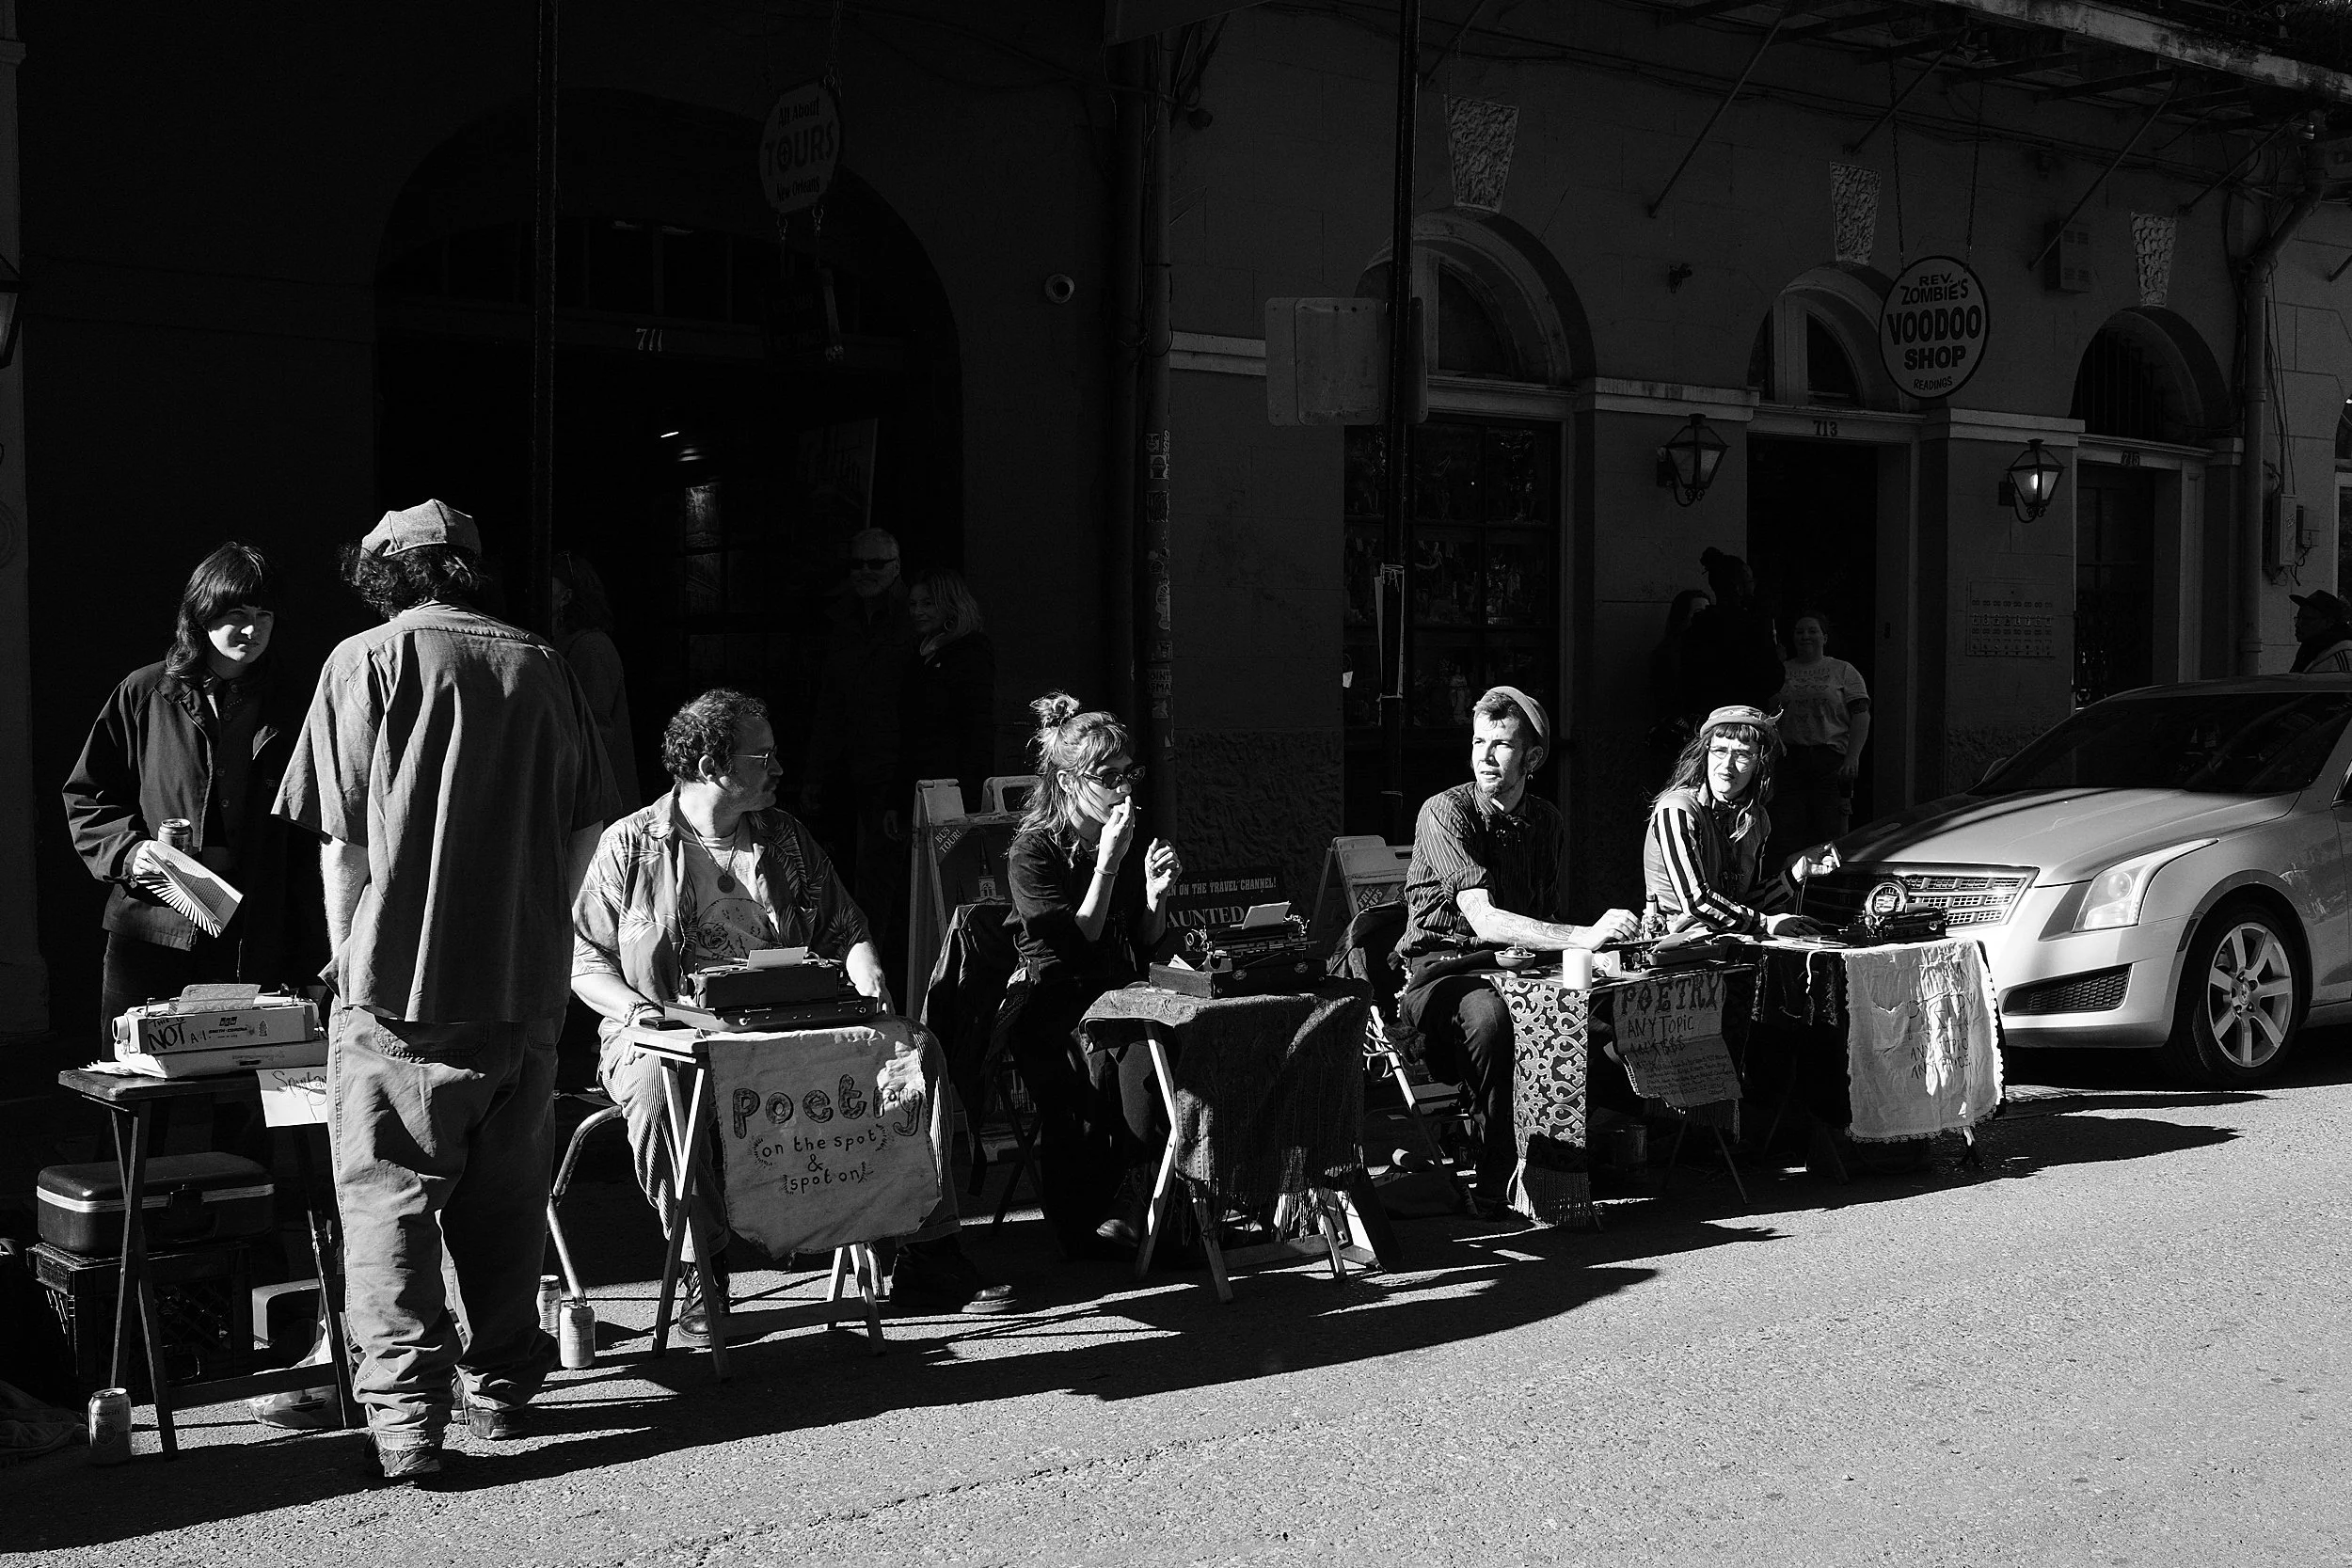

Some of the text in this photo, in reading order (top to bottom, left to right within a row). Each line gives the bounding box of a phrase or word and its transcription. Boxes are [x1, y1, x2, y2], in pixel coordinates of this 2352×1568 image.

[778, 96, 819, 129] All About
[765, 119, 834, 177] TOURS
[1919, 273, 1953, 286] REV.
[1900, 278, 1968, 305] ZOMBIE'S
[1886, 305, 1981, 345] VOODOO
[635, 327, 663, 353] 711
[1904, 345, 1966, 370] SHOP
[1914, 376, 1952, 390] READINGS
[1813, 420, 1837, 437] 713
[934, 826, 950, 844] BUS
[939, 829, 962, 854] TOUR!
[1179, 883, 1189, 895] ON
[1192, 882, 1207, 895] THE
[1210, 880, 1238, 894] TRAVEL
[1240, 877, 1277, 891] CHANNEL!
[1167, 906, 1245, 928] AUNTED
[1621, 974, 1720, 1015] POETRY
[148, 1022, 186, 1051] NOT
[1628, 1017, 1656, 1037] ANY
[794, 1136, 826, 1152] the
[807, 1153, 824, 1172] &
